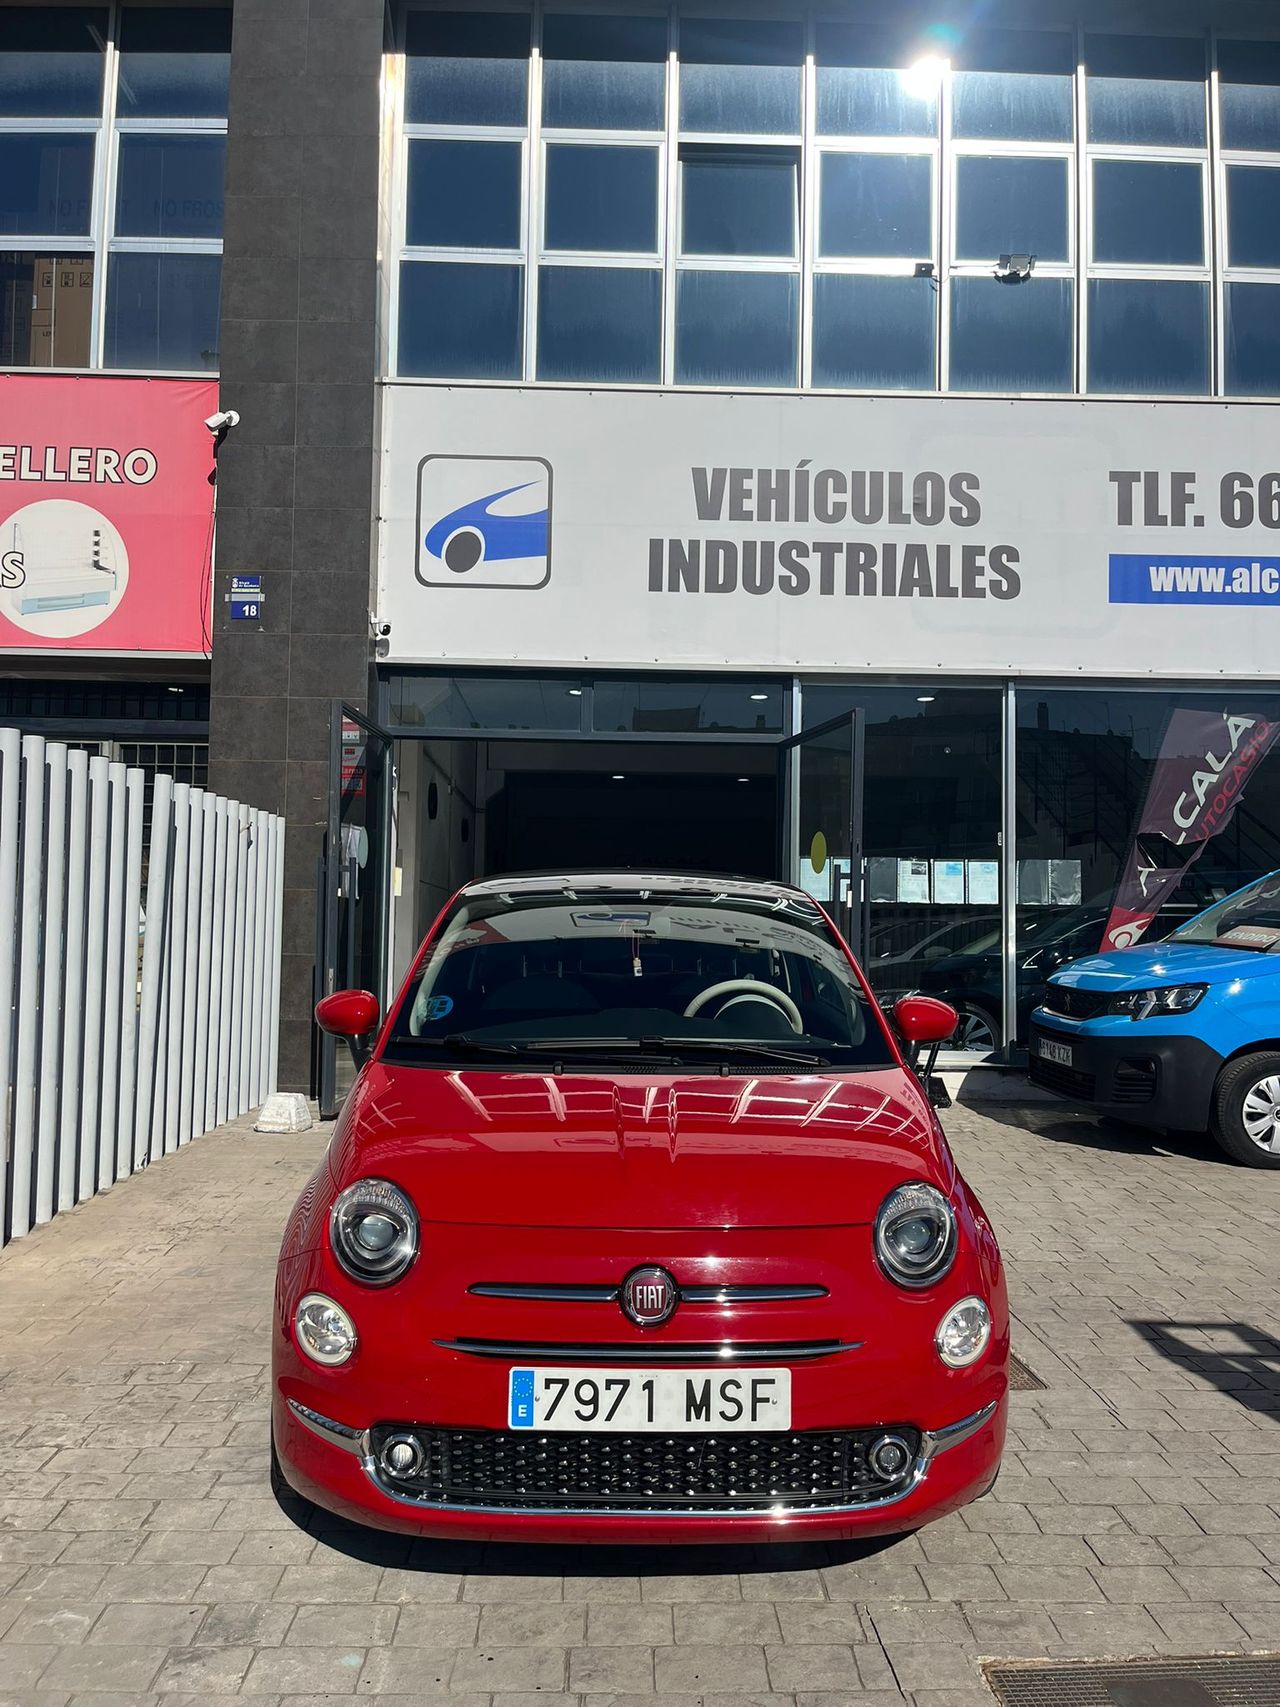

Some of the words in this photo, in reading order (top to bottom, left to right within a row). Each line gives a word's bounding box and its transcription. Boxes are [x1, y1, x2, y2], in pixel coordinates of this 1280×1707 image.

[0, 445, 158, 485] ELLERO
[691, 459, 981, 527] VEHÍCULOS
[1109, 471, 1205, 527] TLF.
[1220, 472, 1280, 529] 66
[0, 551, 26, 589] S
[648, 538, 1021, 600] INDUSTRIALES
[1149, 563, 1279, 594] www.alc
[243, 604, 257, 617] 18
[636, 1285, 664, 1309] FIAT
[518, 1404, 527, 1417] E
[543, 1378, 654, 1422] 7971
[685, 1378, 775, 1422] MSF
